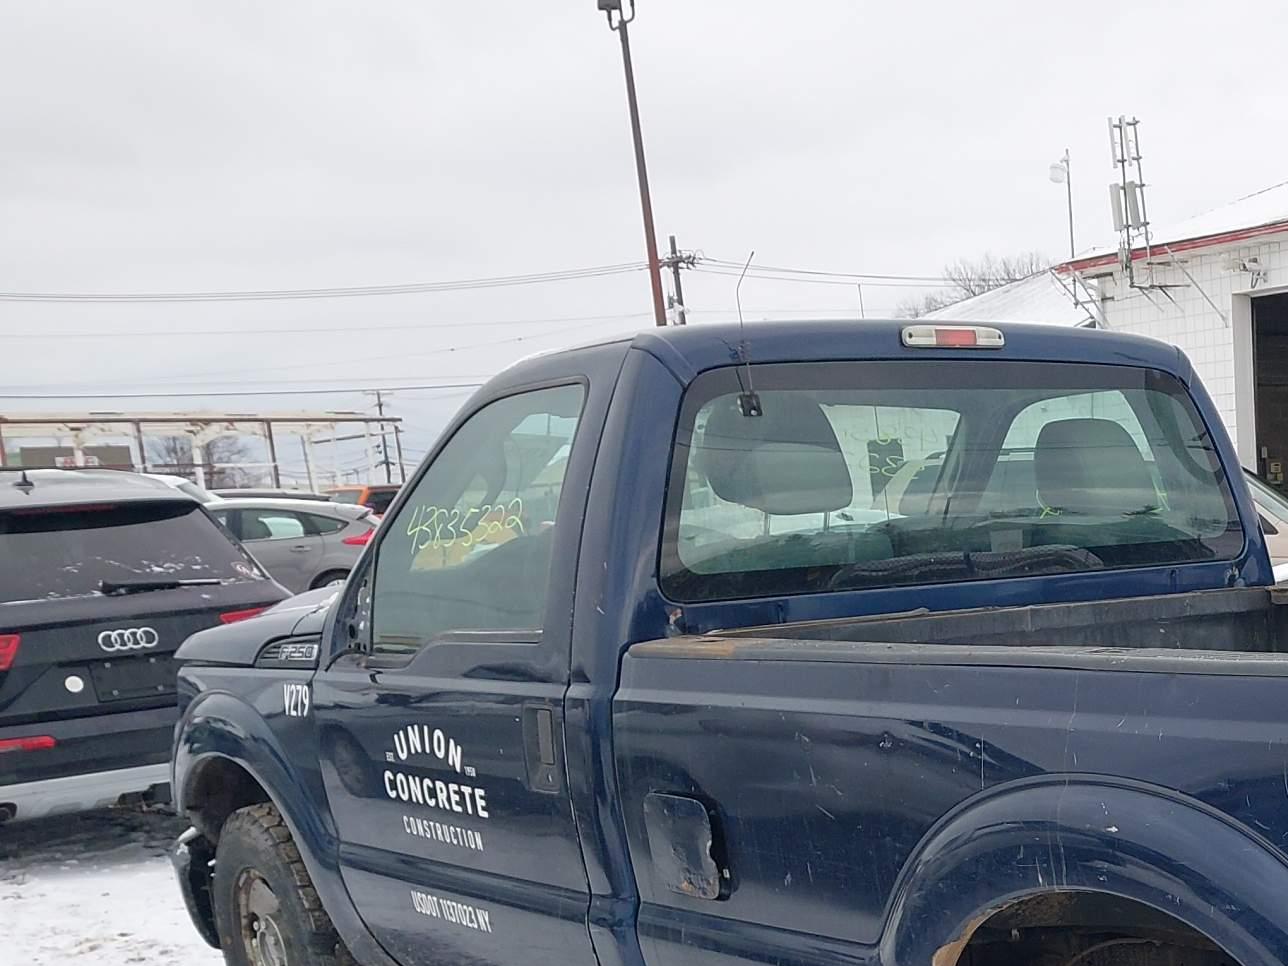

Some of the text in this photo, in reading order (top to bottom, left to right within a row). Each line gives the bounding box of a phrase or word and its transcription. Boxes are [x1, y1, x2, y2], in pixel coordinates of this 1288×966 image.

[407, 498, 524, 554] 43835322
[283, 684, 309, 717] V279
[393, 724, 462, 773] UNION
[384, 770, 489, 818] CONCRETE
[403, 815, 484, 851] CONSTRUCTION
[411, 890, 441, 918] USDOT
[476, 908, 492, 933] NY
